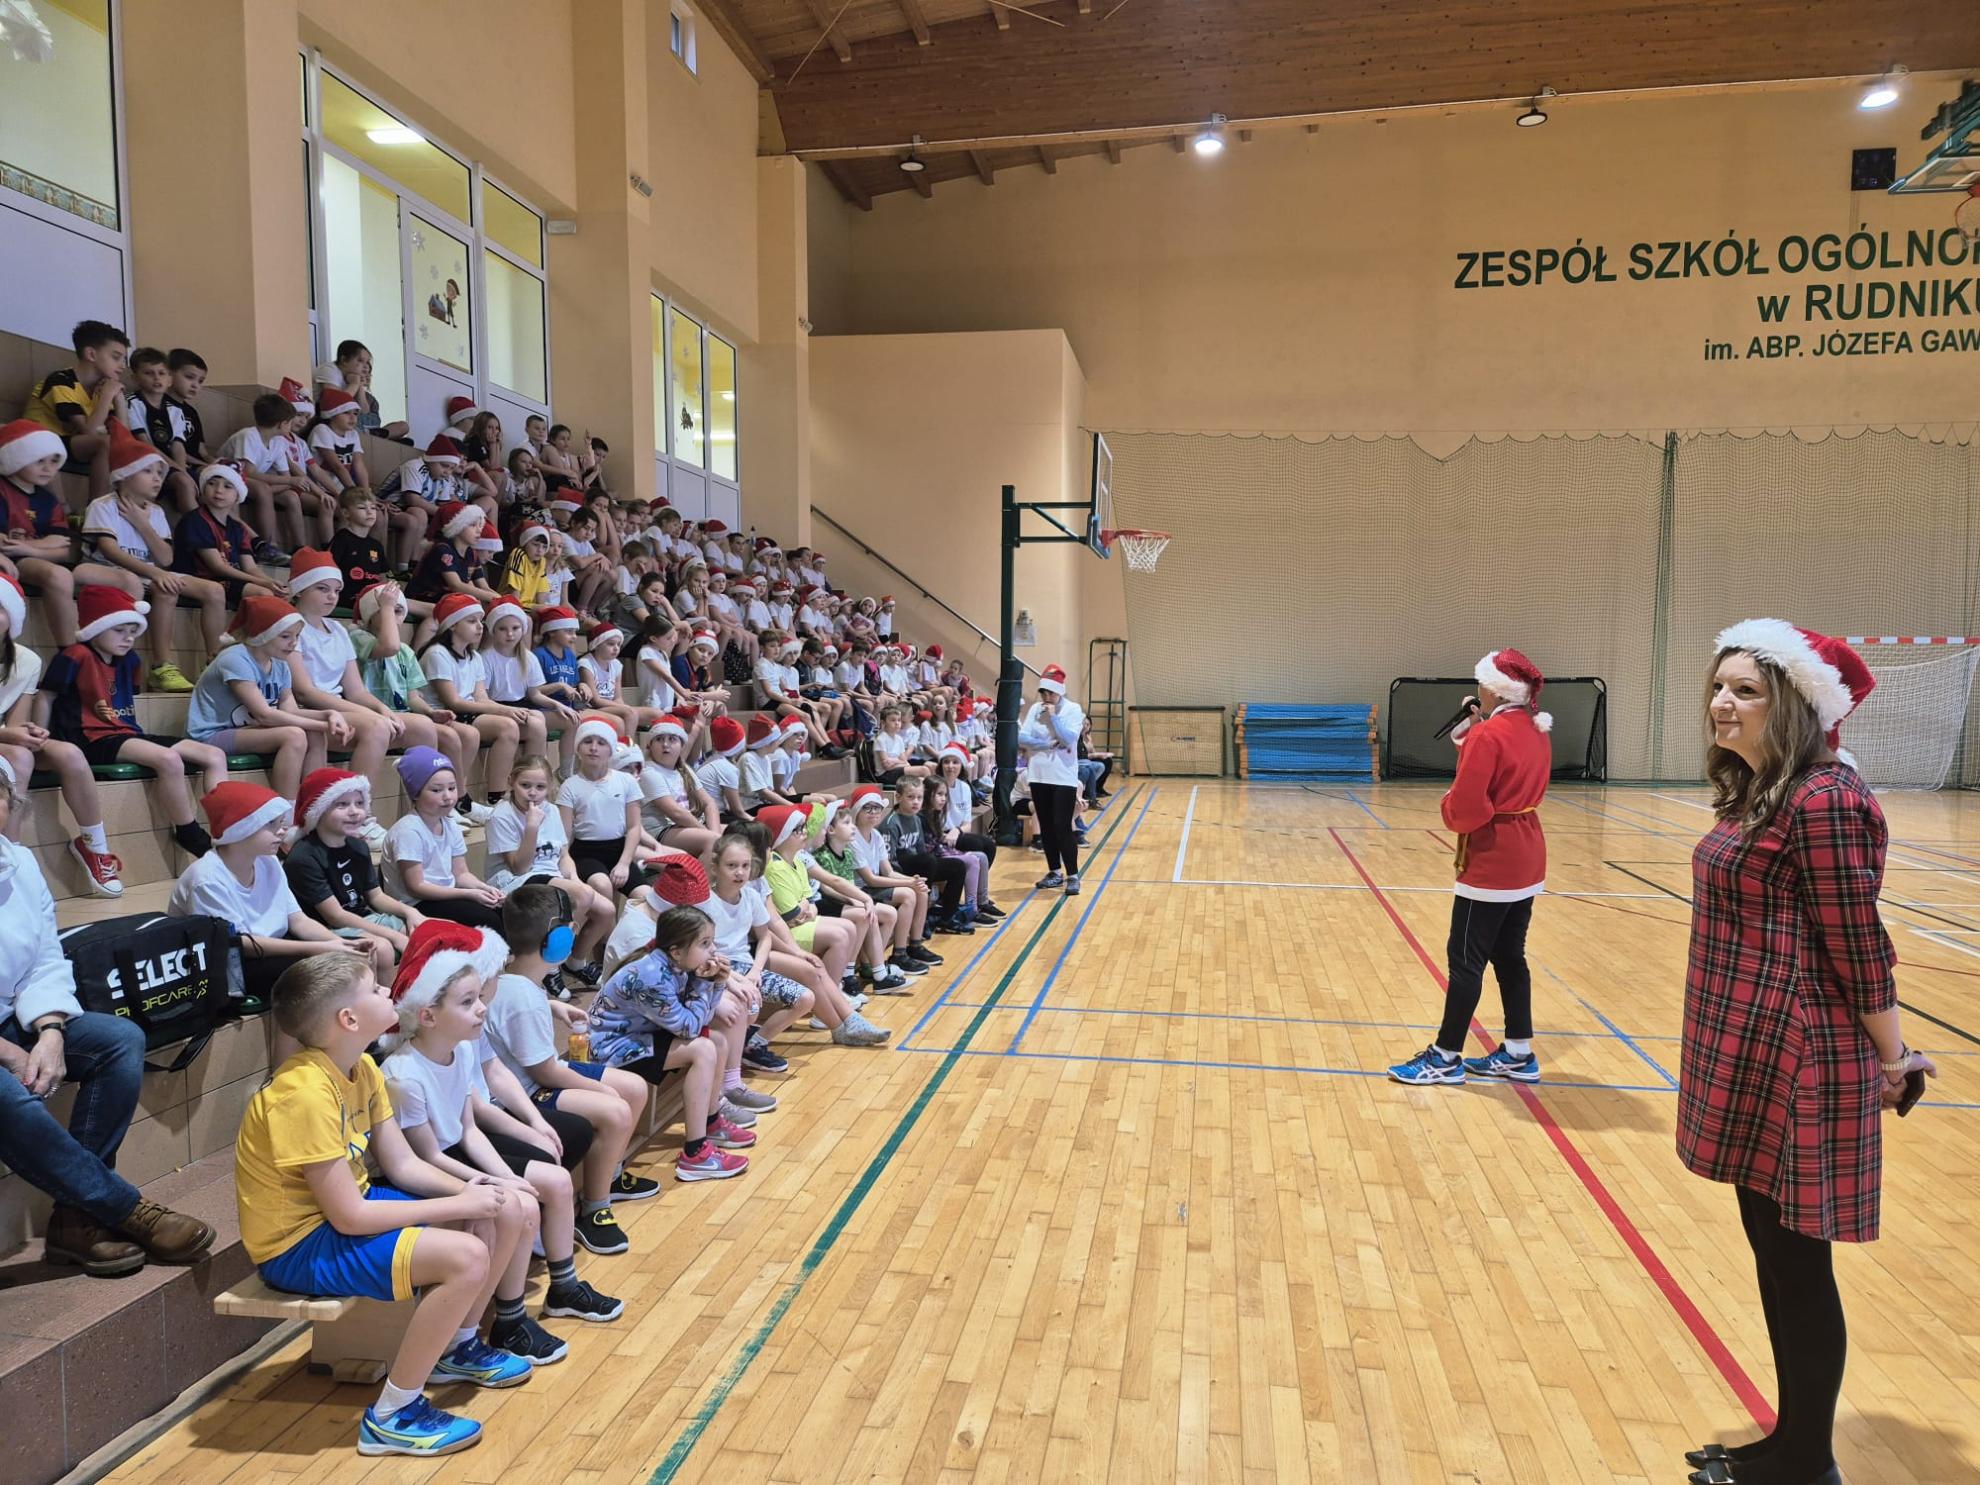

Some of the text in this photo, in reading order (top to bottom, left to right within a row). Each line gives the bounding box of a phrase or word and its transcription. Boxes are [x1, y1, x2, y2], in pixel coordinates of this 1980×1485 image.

[1454, 222, 1980, 289] ZESPÓŁ SZKÓŁ OGÓLNO
[1756, 277, 1980, 323] w RUDNIK
[1704, 338, 1740, 361] im.
[1746, 335, 1804, 359] ABP.
[1812, 328, 1913, 357] JÓZEFA
